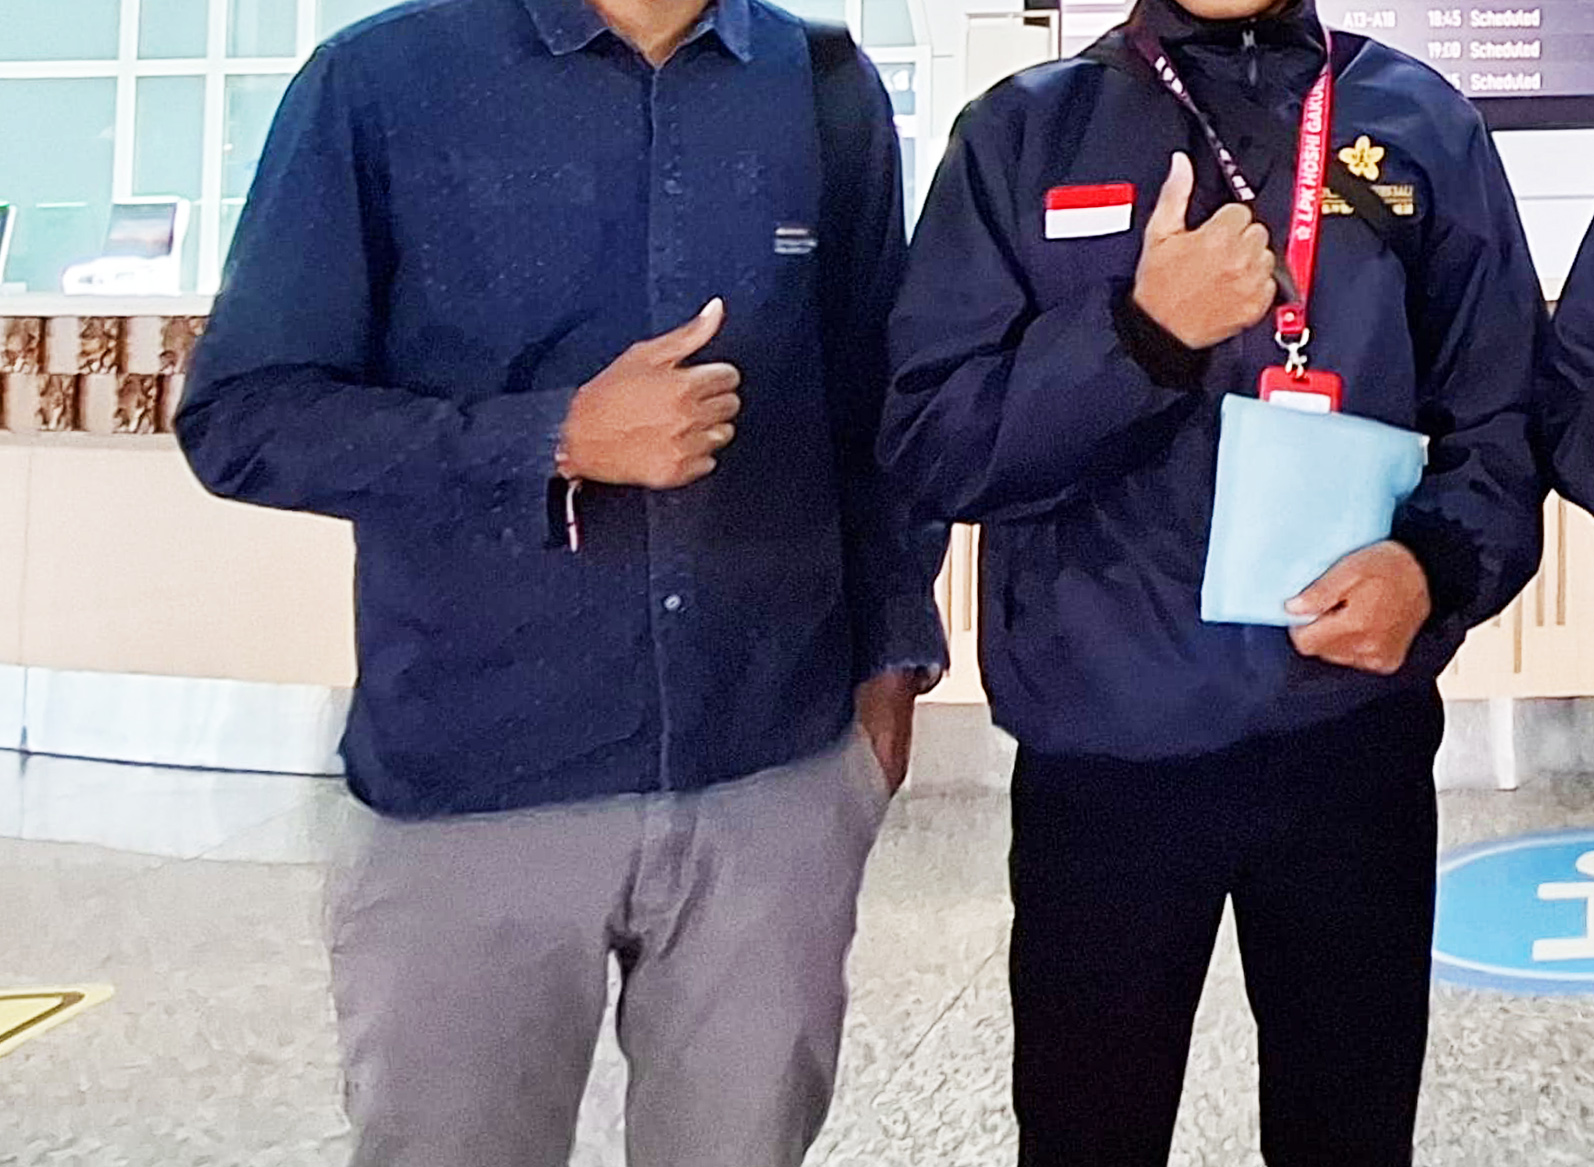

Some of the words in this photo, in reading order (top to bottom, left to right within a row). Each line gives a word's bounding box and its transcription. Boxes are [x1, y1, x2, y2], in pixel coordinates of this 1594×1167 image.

[1470, 9, 1540, 27] Scheduled
[1469, 40, 1540, 59] Scheduled
[1469, 74, 1541, 92] Scheduled
[1301, 134, 1321, 188] HOSHI
[1297, 187, 1317, 222] LPK
